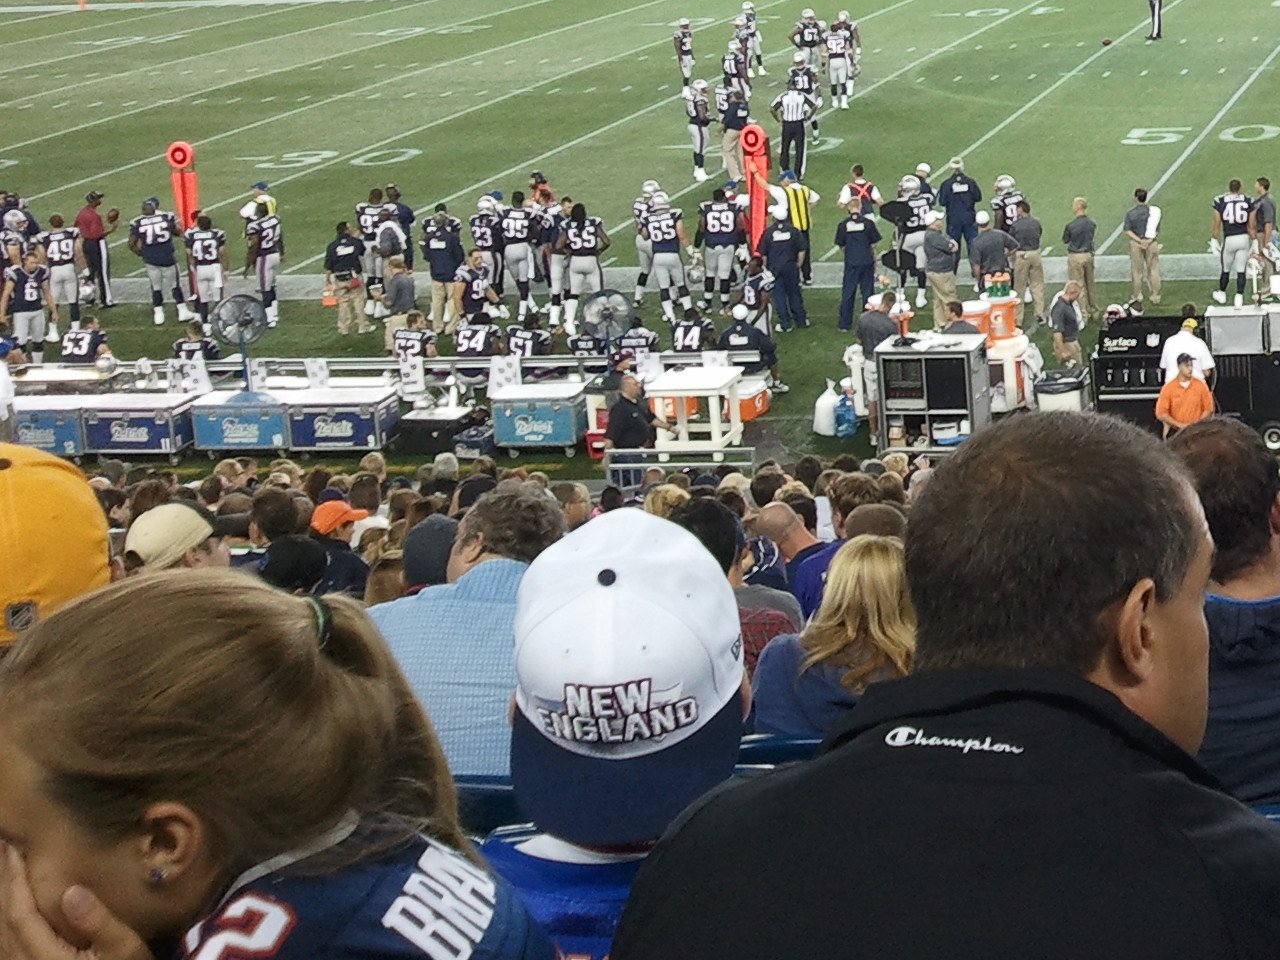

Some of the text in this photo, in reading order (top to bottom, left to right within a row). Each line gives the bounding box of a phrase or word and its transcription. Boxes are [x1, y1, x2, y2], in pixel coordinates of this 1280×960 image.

[706, 211, 735, 233] 69
[1222, 202, 1249, 225] 46
[139, 223, 171, 244] 75
[567, 227, 596, 250] 55
[647, 218, 677, 243] 65
[46, 240, 74, 262] 49
[192, 240, 219, 262] 43
[24, 281, 38, 303] 6
[61, 332, 91, 356] 53
[456, 329, 487, 352] 54
[673, 326, 701, 351] 44
[1103, 337, 1138, 347] Surface
[565, 677, 652, 719] NEW
[536, 695, 699, 744] ENGLAND
[885, 726, 1025, 754] Champion
